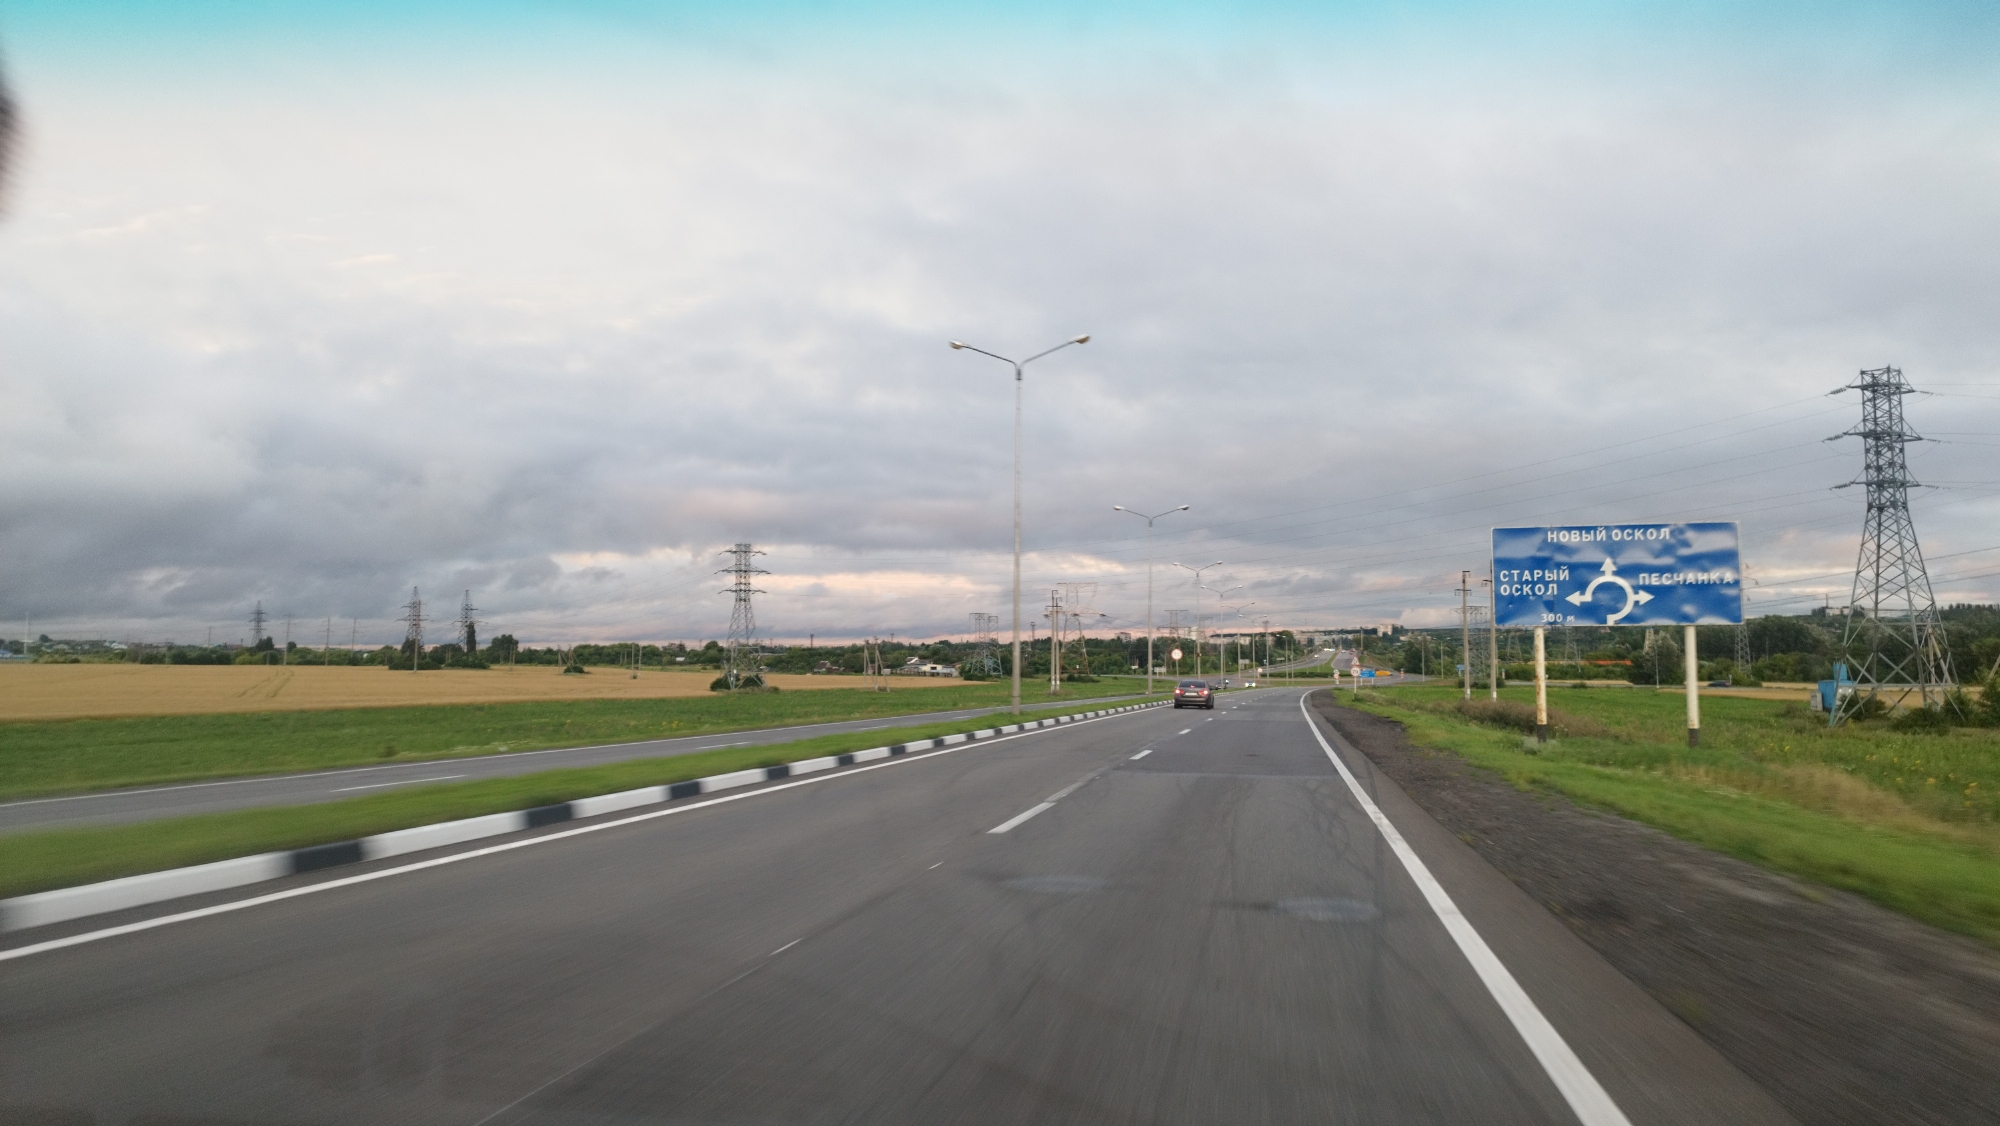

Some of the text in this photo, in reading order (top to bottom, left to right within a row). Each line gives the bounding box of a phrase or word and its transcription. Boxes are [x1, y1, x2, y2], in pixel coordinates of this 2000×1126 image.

[1547, 526, 1671, 542] НОВЫЙ ОСКОЛ
[1500, 566, 1570, 582] СТАРЫЙ
[1638, 571, 1734, 586] ПЕСЧАНКА
[1500, 584, 1558, 596] ОСКОЛ
[1541, 614, 1563, 623] 300
